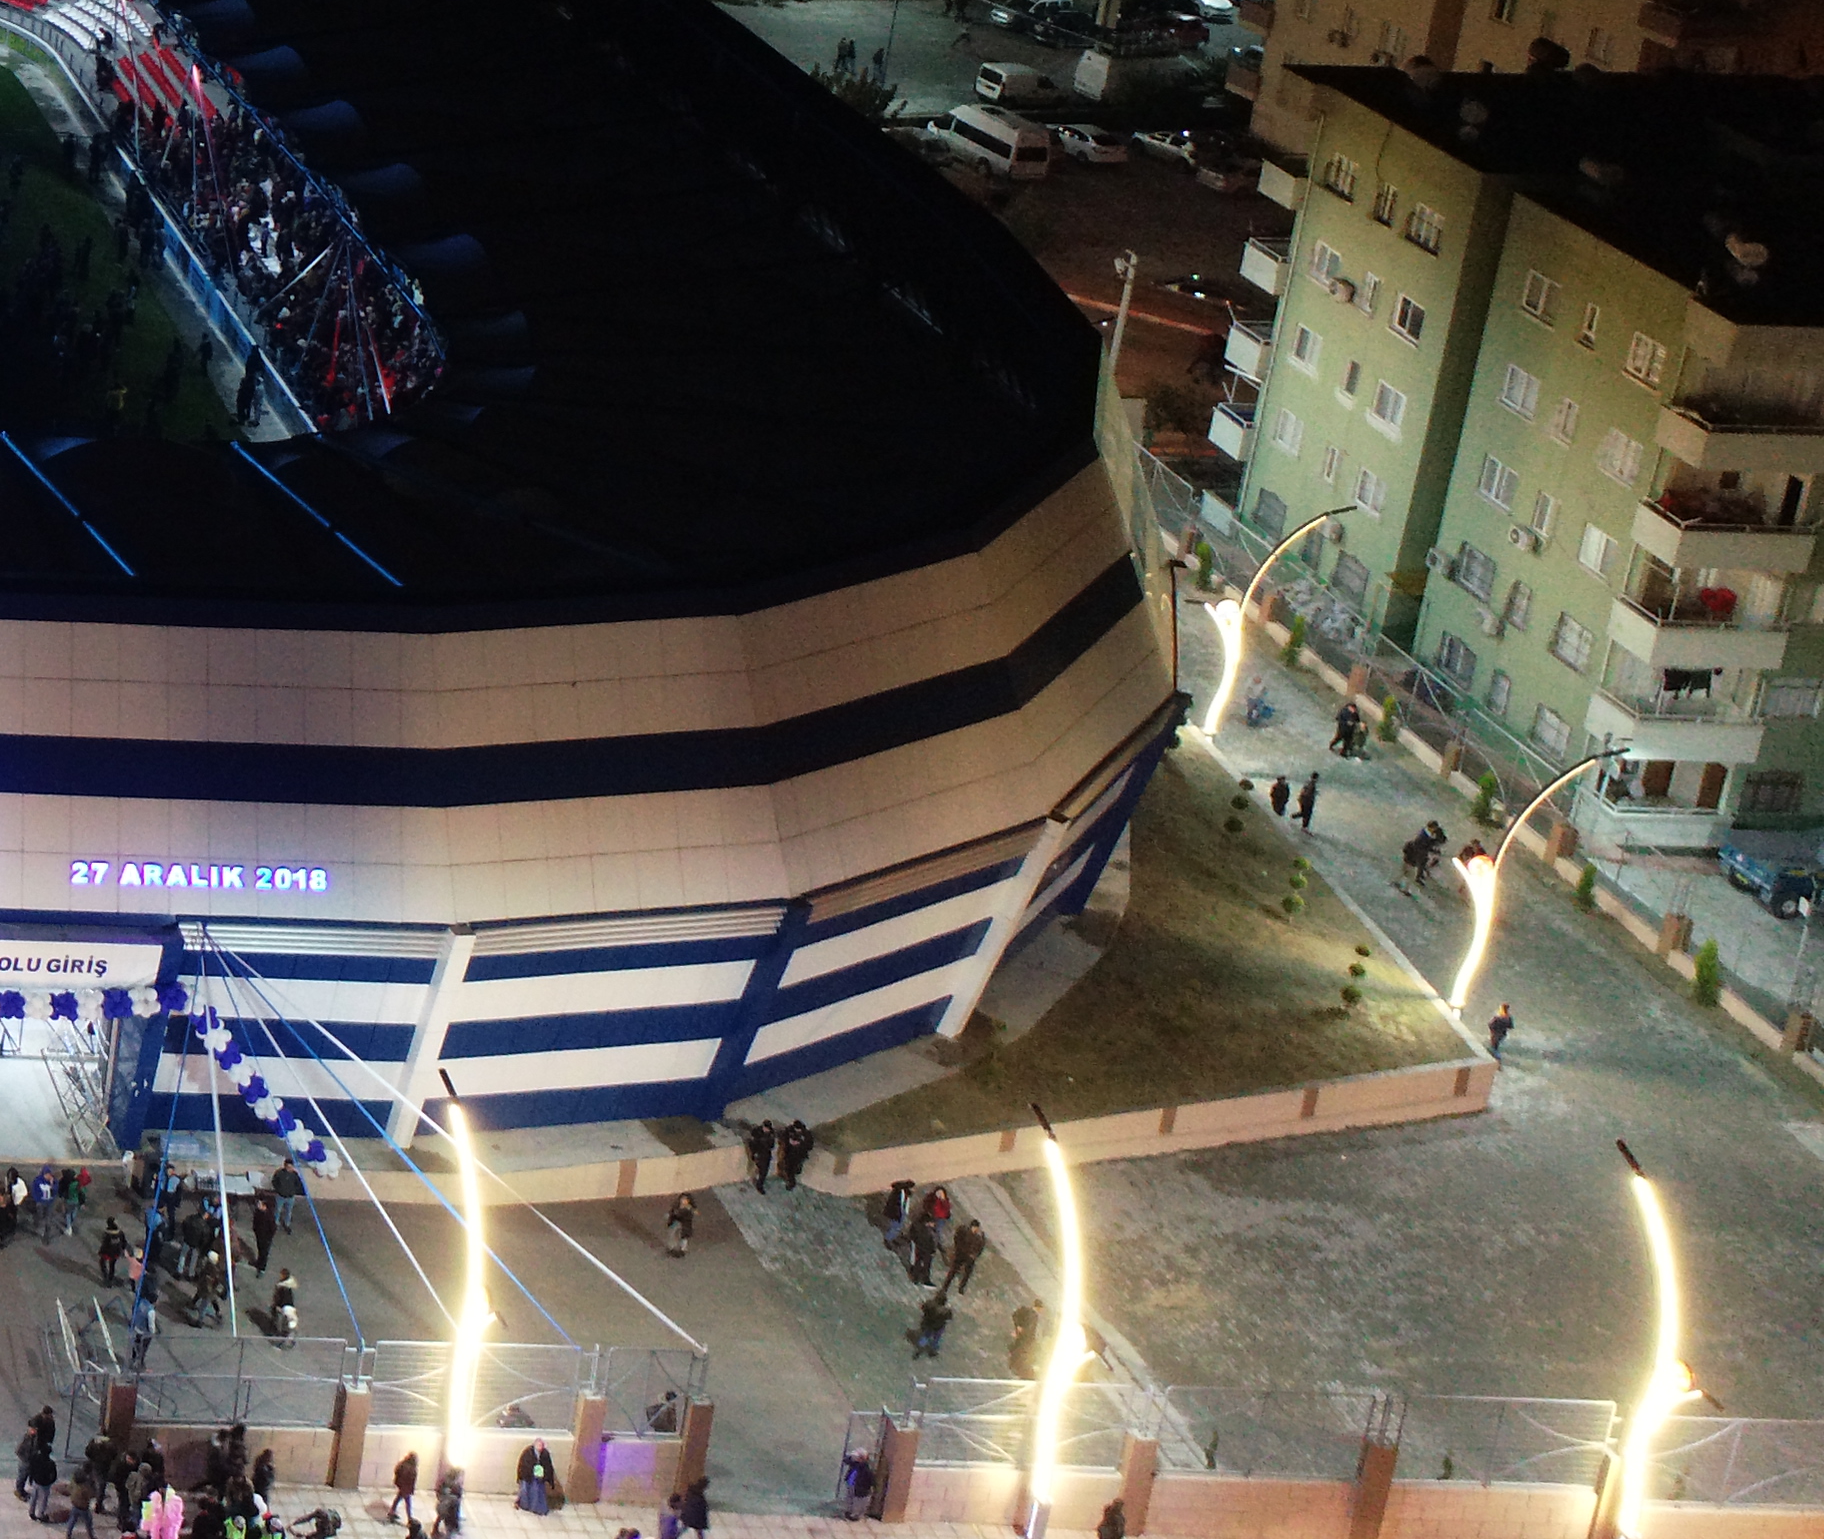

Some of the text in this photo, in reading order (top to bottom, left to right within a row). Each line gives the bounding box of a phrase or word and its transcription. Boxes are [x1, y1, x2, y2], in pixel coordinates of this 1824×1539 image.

[70, 858, 328, 891] 27 ARALIK 2018
[46, 954, 108, 979] GİRİŞ
